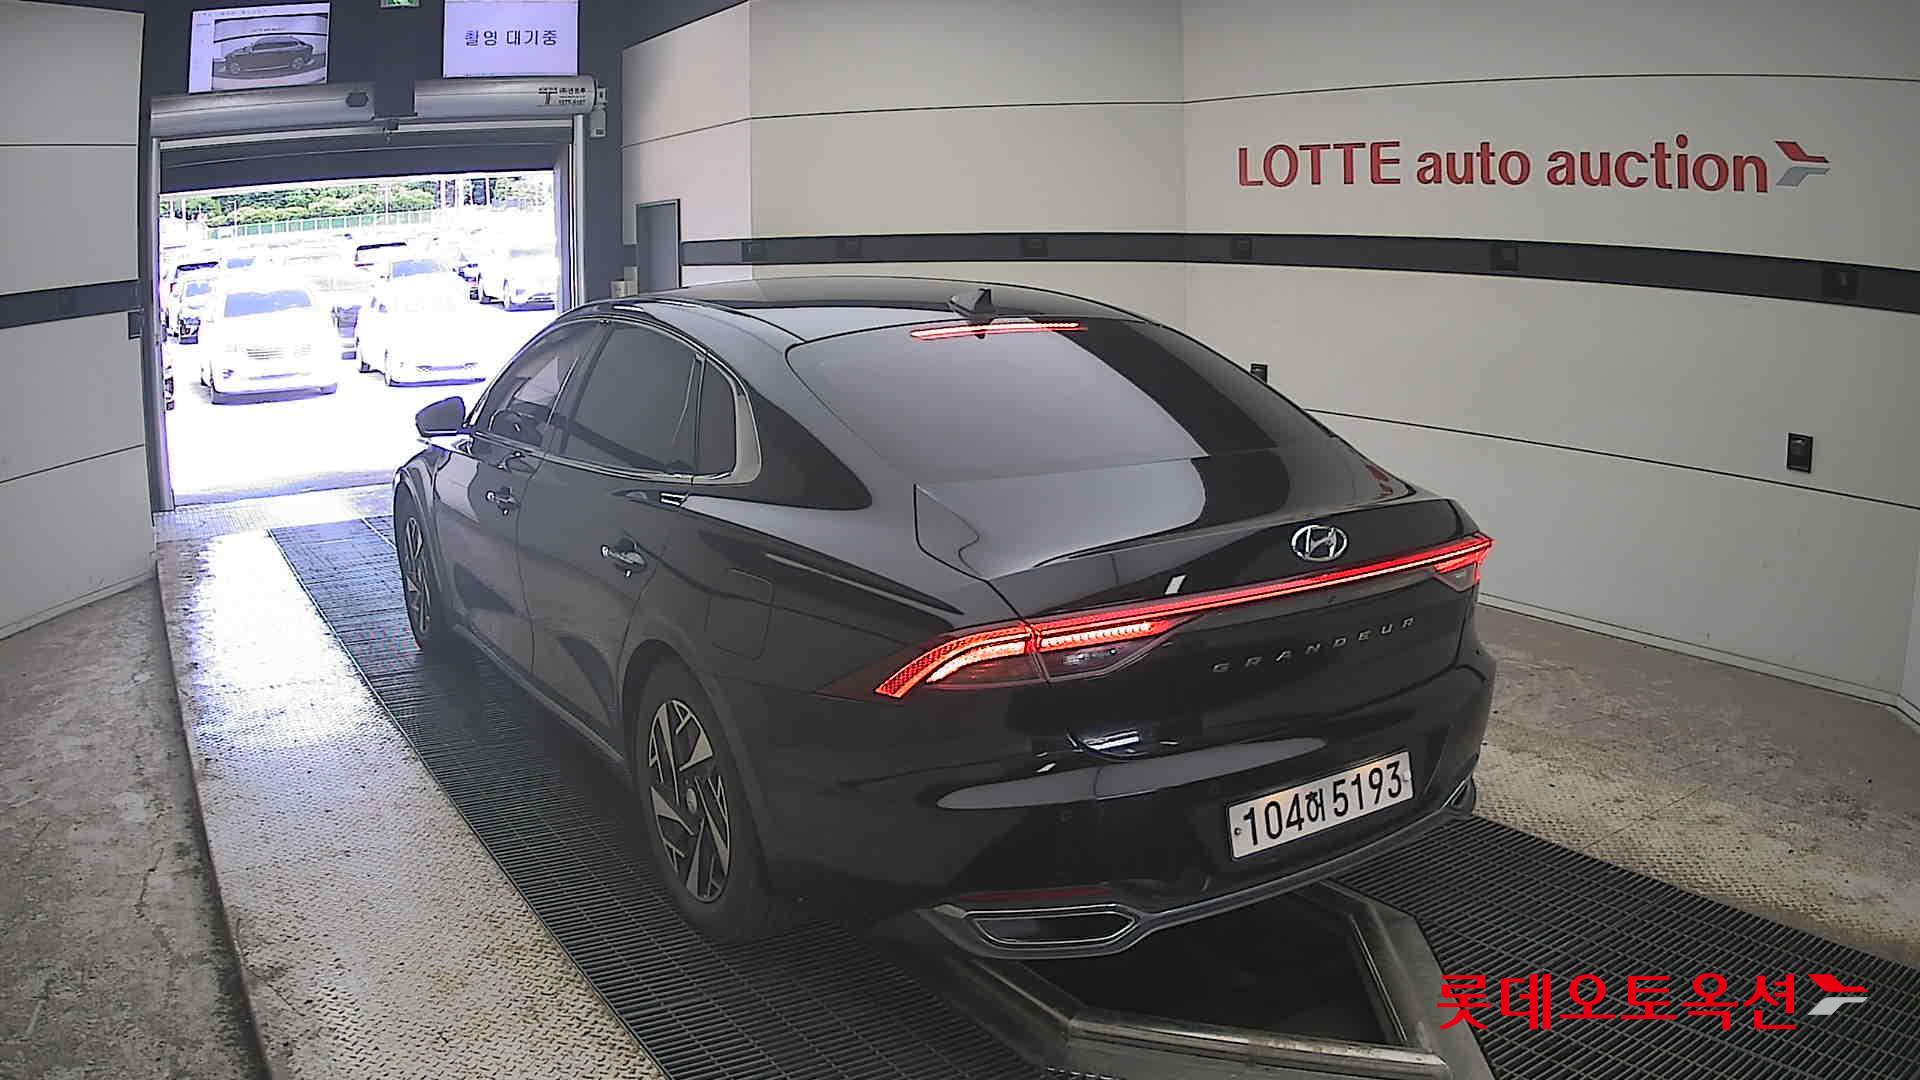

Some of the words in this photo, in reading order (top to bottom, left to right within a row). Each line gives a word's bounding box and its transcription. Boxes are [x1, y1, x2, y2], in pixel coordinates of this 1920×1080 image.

[506, 30, 557, 46] 대기중
[1238, 141, 1401, 188] LOTTE
[1416, 142, 1531, 186] auto
[1547, 134, 1768, 193] auction
[1212, 616, 1415, 673] GRANDEUR
